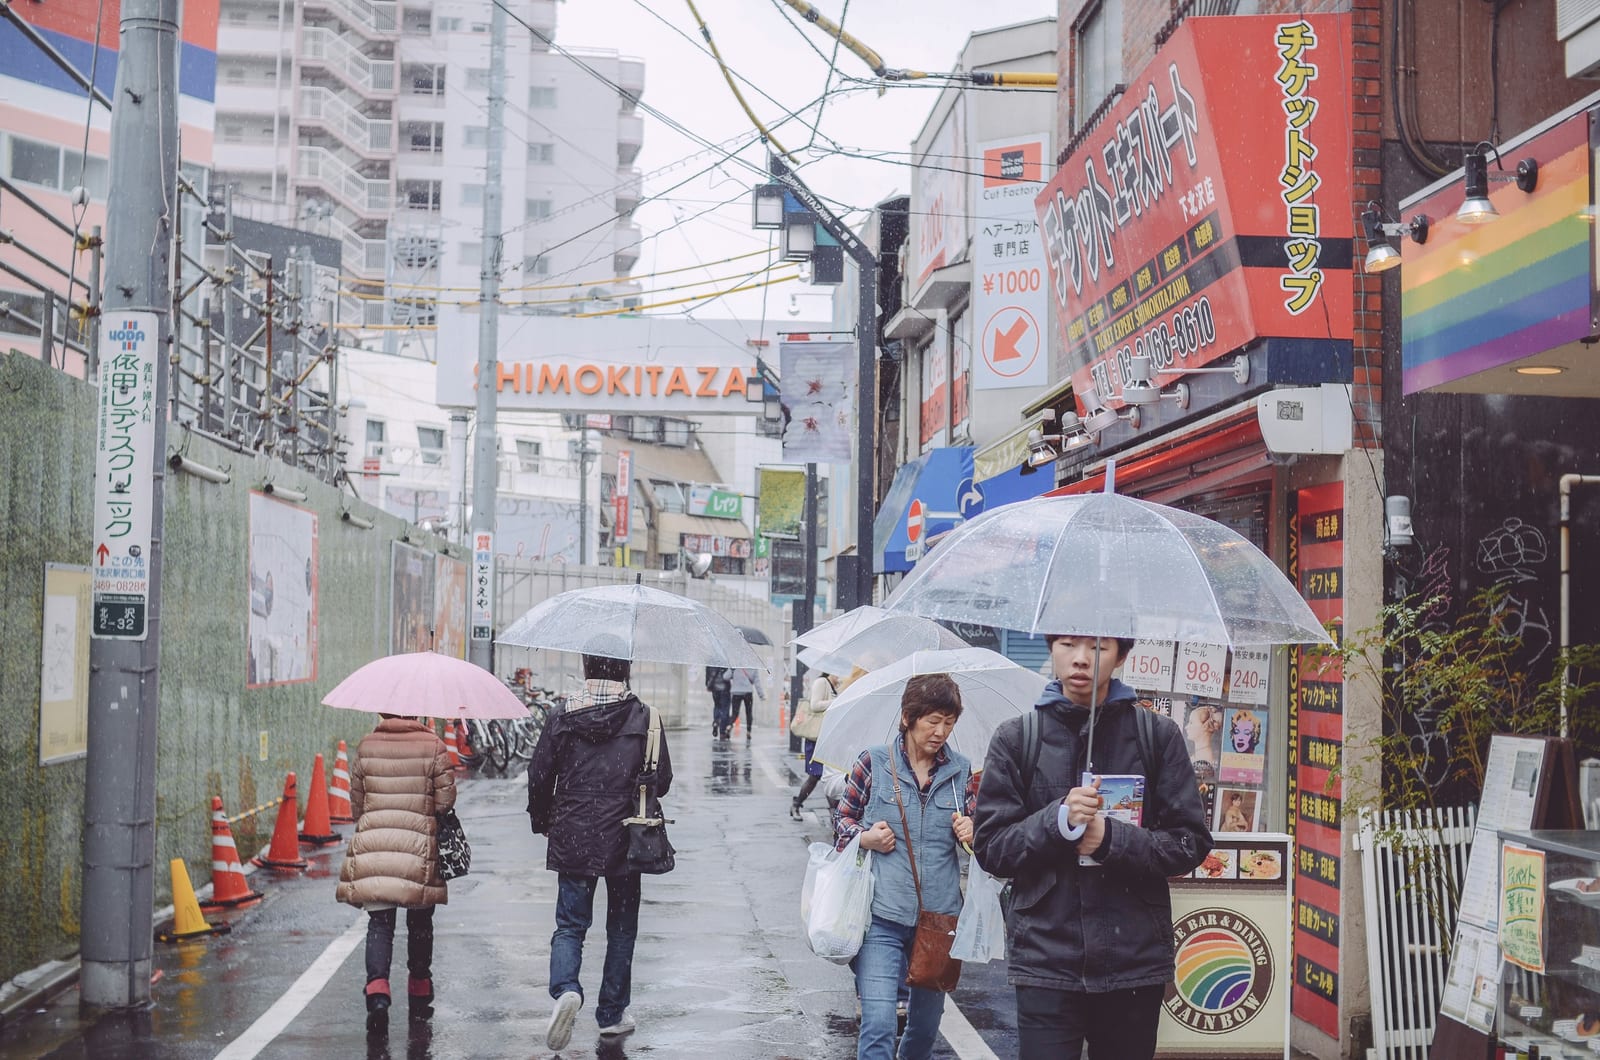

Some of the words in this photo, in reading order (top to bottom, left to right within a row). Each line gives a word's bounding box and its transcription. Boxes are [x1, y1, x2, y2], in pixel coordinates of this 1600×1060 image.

[1275, 22, 1320, 314] チケットショップ
[983, 188, 1000, 201] Cut
[1003, 185, 1041, 199] Factory
[1043, 60, 1199, 308] チケットエキスパート
[1179, 175, 1216, 224] 下北沢店
[983, 219, 1039, 238] ヘアーカット
[993, 240, 1030, 258] 専門店
[983, 267, 1042, 297] ¥1000
[1113, 311, 1136, 341] EXPERT
[1135, 274, 1191, 329] SHIMOKITAZAWA
[473, 360, 758, 398] HIMOKITAZA
[105, 354, 140, 538] 依田レディスクリニック
[714, 495, 739, 513] レイク
[1316, 515, 1338, 538] 商品券
[1310, 572, 1338, 594] ギフト券
[100, 618, 135, 630] 2-32
[1131, 655, 1171, 676] 150円
[1184, 648, 1208, 658] セール
[1186, 660, 1221, 685] 98%
[1233, 669, 1267, 690] 240円
[1301, 686, 1338, 709] マックカード
[1308, 740, 1337, 766] 新幹線券
[1300, 849, 1336, 882] 切手・印紙
[1300, 904, 1335, 938] 図書カード
[1187, 914, 1218, 931] BAR
[1220, 915, 1231, 928] &
[1232, 920, 1267, 966] DINING
[1304, 963, 1334, 996] ビール券
[1167, 992, 1260, 1030] RAINBOW
